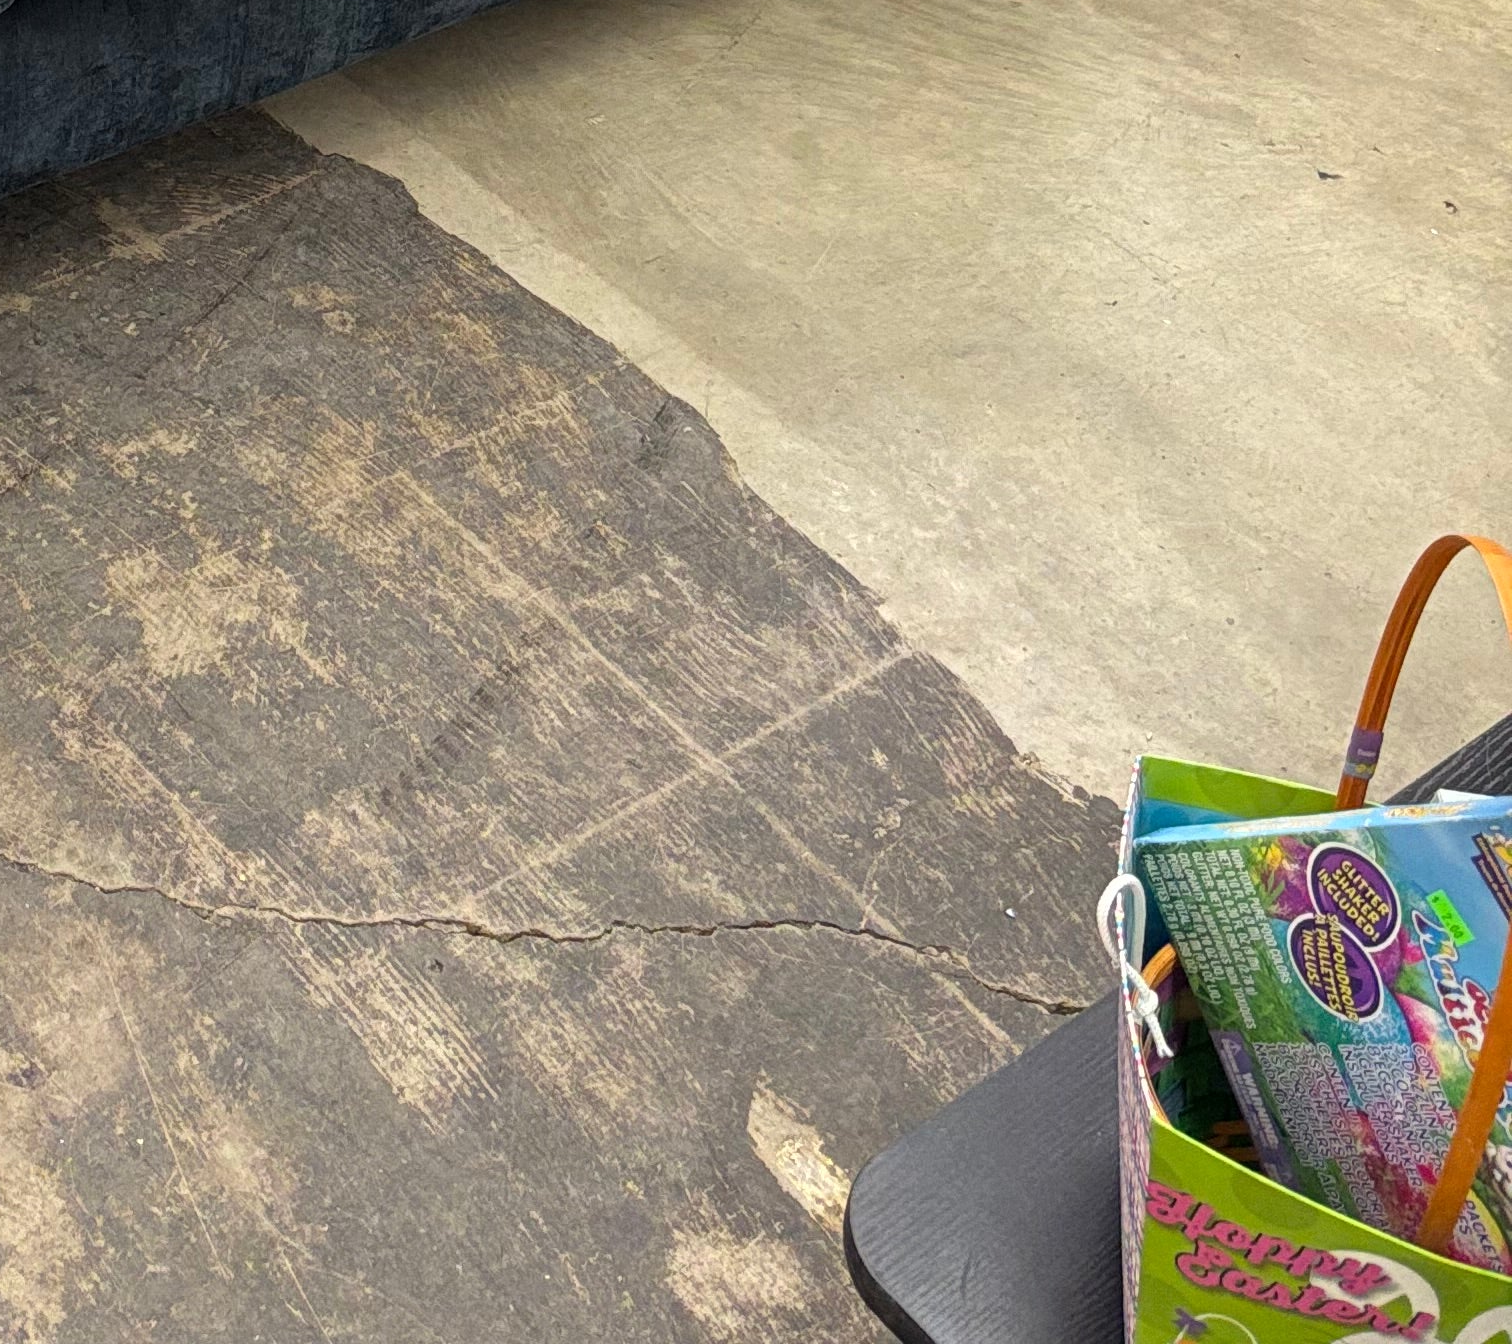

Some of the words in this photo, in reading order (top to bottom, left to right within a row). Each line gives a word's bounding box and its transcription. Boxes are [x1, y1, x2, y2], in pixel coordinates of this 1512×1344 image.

[1143, 854, 1170, 901] PAILLETTES
[1178, 852, 1206, 902] COLORANTS
[1205, 850, 1224, 877] TOTAL
[1209, 891, 1223, 907] NET
[1332, 869, 1381, 924] SHAKER
[1341, 861, 1390, 916] GLITTER
[1230, 848, 1255, 894] NON-TOXIC
[1249, 897, 1266, 921] PURE
[1260, 922, 1276, 946] FOOD
[1270, 948, 1291, 983] COLORS
[1317, 868, 1380, 943] INCLUDED!
[1302, 929, 1323, 988] INCLUS!
[1316, 928, 1343, 1012] PAILLETTES
[1327, 913, 1360, 1024] SAUPOUDROIR
[1252, 1044, 1280, 1087] MODE
[1307, 1060, 1346, 1127] SACHETS
[1339, 1046, 1399, 1162] INSTRUCTIONS
[1410, 1044, 1459, 1130] CONTENTS
[1281, 1059, 1333, 1156] COQUETIERS
[1297, 1067, 1346, 1156] POCHETTES
[1357, 1058, 1394, 1119] GLITTER
[1386, 1127, 1423, 1186] SHAKER
[1373, 1062, 1396, 1093] EGG
[1388, 1100, 1426, 1162] STANDS
[1390, 1069, 1436, 1152] COLORING
[1175, 1240, 1436, 1341] Easter!
